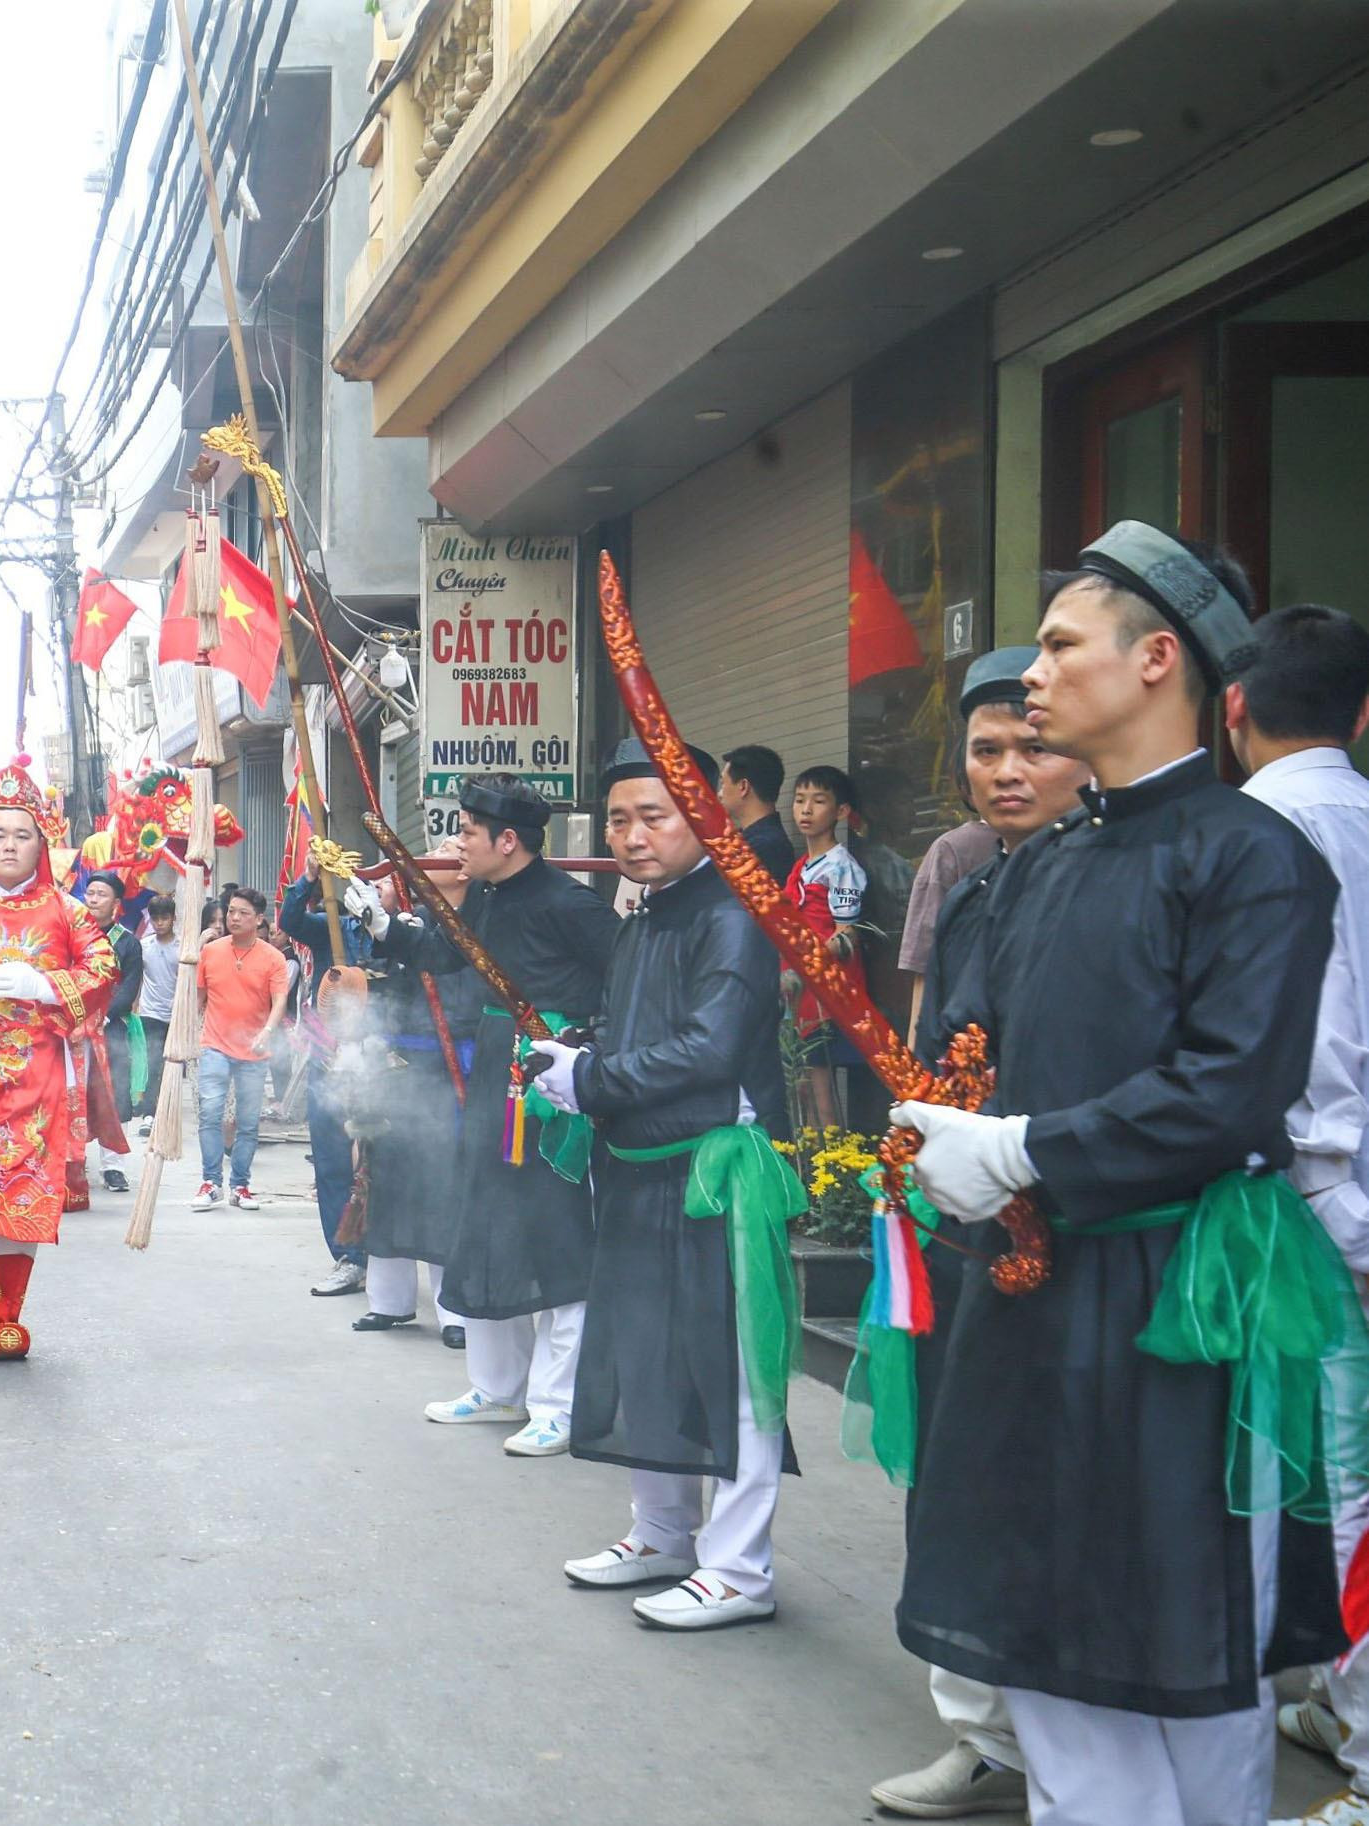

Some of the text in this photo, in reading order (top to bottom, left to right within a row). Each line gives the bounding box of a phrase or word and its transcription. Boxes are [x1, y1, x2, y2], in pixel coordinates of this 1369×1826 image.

[432, 536, 571, 561] Minh Chiến
[435, 568, 507, 598] Chuyên
[432, 602, 568, 664] CẮT TÓC
[952, 612, 963, 645] 6
[452, 667, 527, 681] 0969382683
[461, 681, 539, 727] NAM
[432, 734, 569, 771] NHUỘM, GỘI
[432, 774, 465, 796] LẤ
